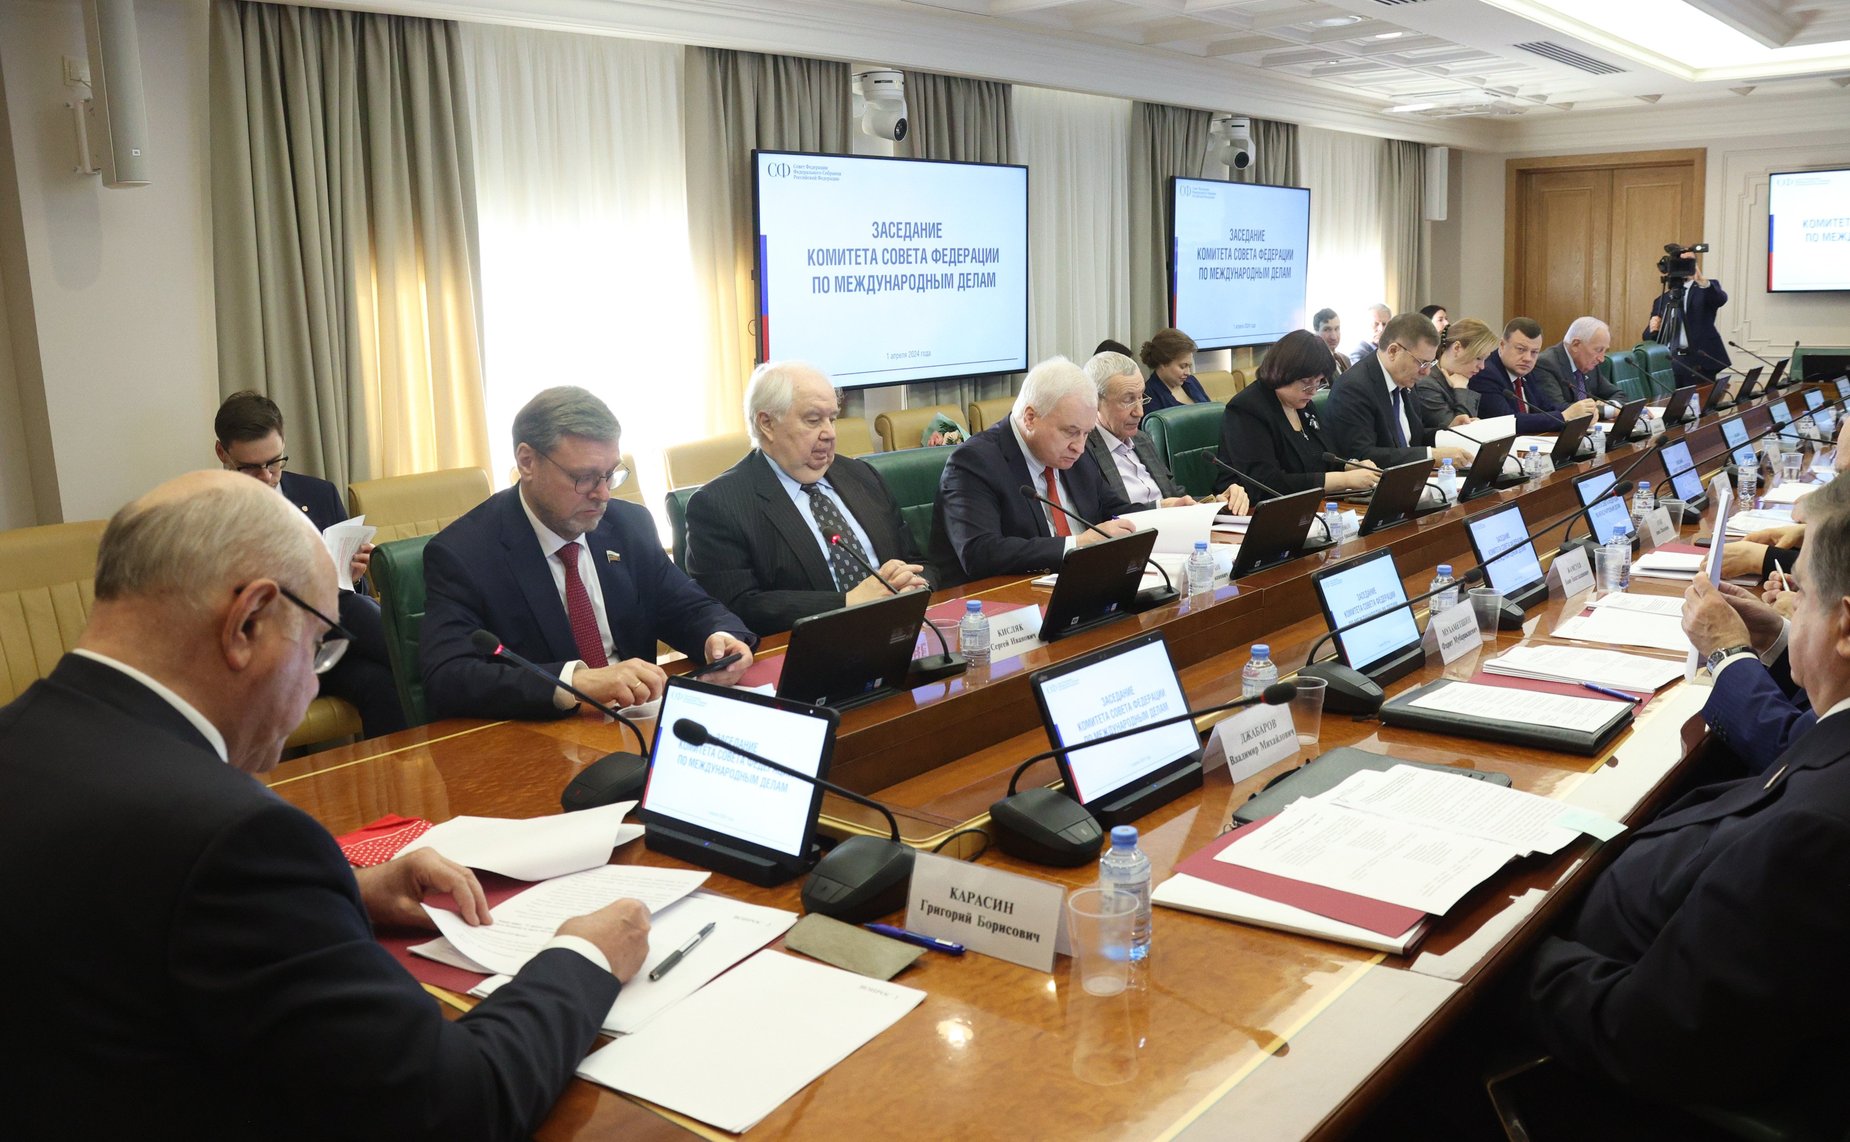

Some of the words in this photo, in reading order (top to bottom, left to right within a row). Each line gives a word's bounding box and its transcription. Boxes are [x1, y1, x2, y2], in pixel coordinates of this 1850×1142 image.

[768, 163, 790, 178] СФ
[872, 221, 943, 241] ЗАСЕДАНИЕ
[1229, 228, 1265, 243] ЗАСЕДАНИЕ
[807, 248, 878, 266] КОМИТЕТА
[881, 248, 928, 265] СОВЕТА
[931, 247, 1000, 267] ФЕДЕРАЦИИ
[1197, 247, 1232, 261] КОМИТЕТА
[1233, 247, 1257, 261] СОВЕТА
[1258, 248, 1294, 263] ФЕДЕРАЦИИ
[812, 276, 830, 294] ПО
[834, 273, 954, 295] МЕЖДУНАРОДНЫМ
[957, 271, 996, 292] ДЕЛАМ
[1198, 267, 1209, 280] ПО
[1209, 267, 1270, 282] МЕЖДУНАРОДНЫМ
[1270, 267, 1292, 281] ДЕЛАМ
[997, 623, 1024, 638] КИСЛЯК
[990, 639, 1010, 651] Сергей
[1010, 633, 1037, 645] Иванович
[1240, 718, 1277, 745] ДЖАБАРОВ
[1229, 746, 1260, 766] Владимир
[1259, 729, 1295, 750] Михайлович
[760, 776, 789, 793] ДЕЛАМ
[949, 887, 1015, 915] КАРАСИН
[920, 899, 972, 925] Григорий
[977, 914, 1041, 943] Борисович
